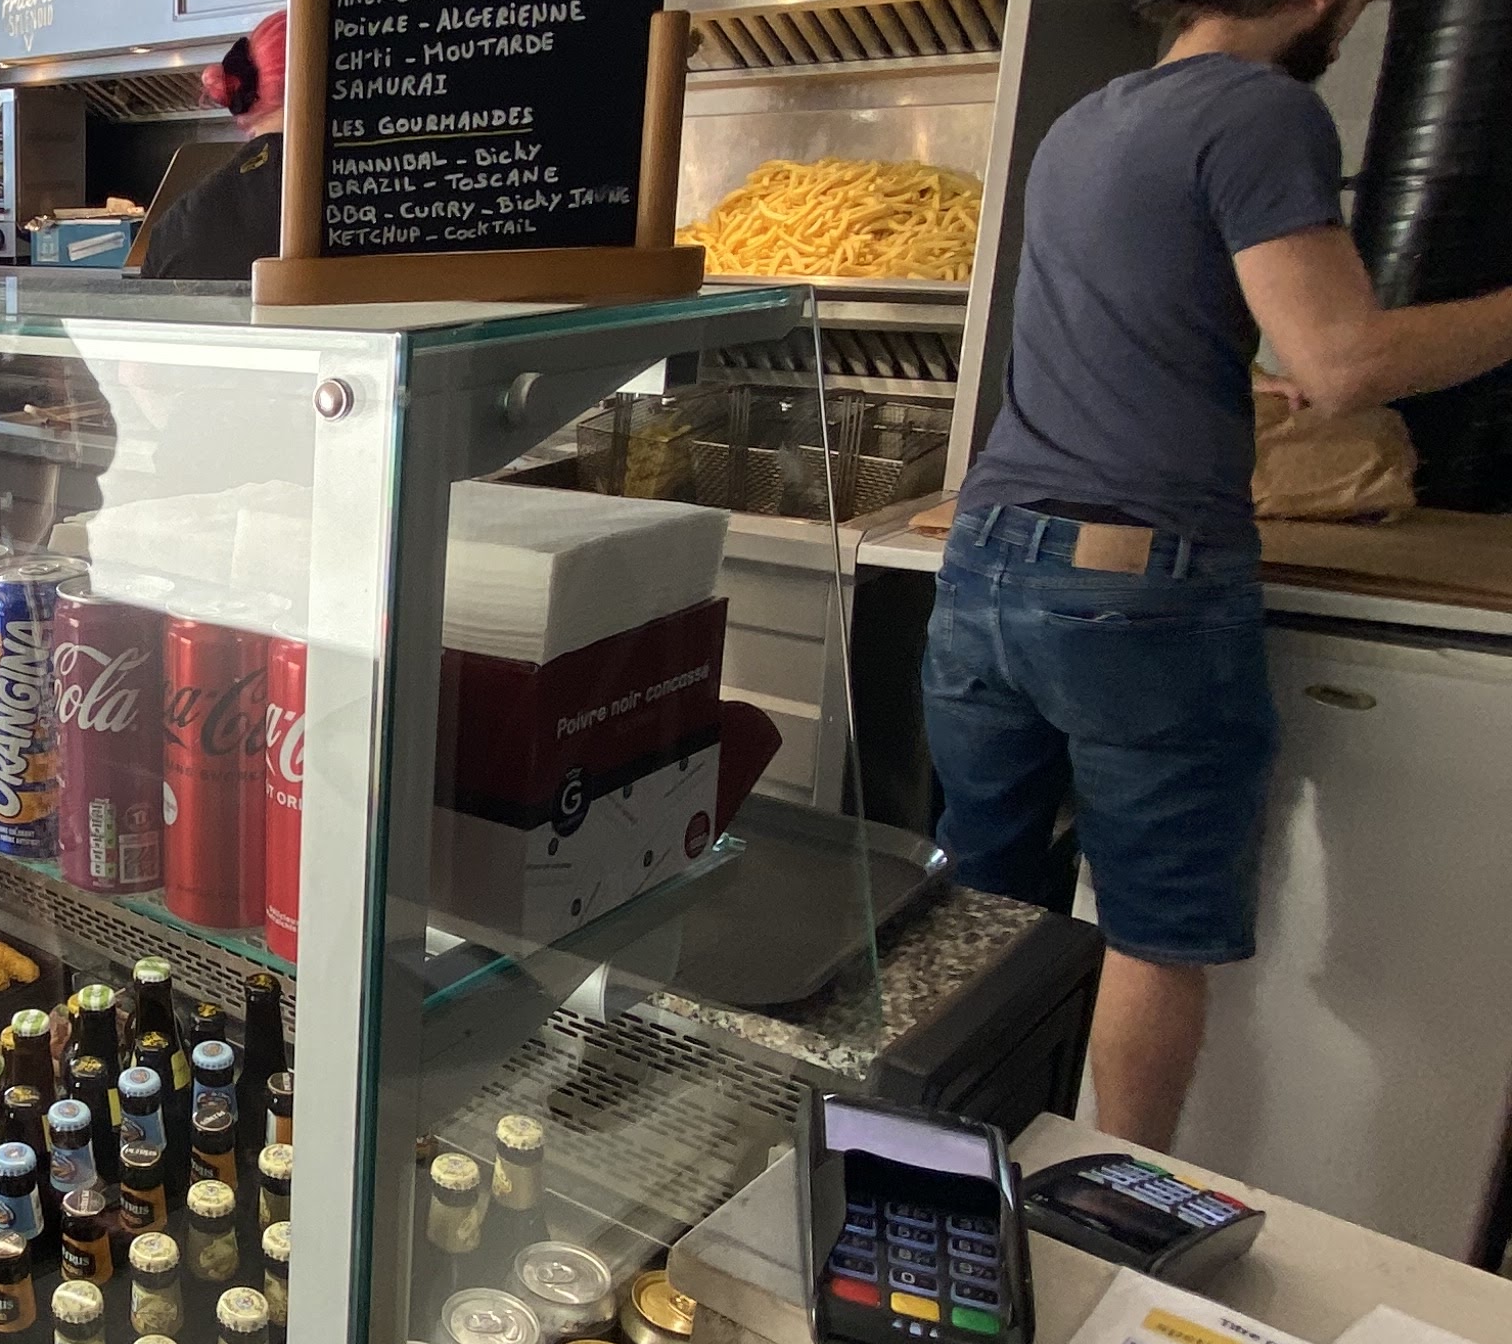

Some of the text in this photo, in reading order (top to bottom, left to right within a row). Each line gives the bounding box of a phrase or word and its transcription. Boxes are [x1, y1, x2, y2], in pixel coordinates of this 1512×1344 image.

[423, 31, 555, 66] MOUTARDE
[332, 72, 448, 101] SAMURAI
[331, 106, 535, 139] LES GOURMANDES
[332, 139, 543, 176] HANNIBAL Bicky
[328, 166, 560, 199] BRAZIL TOSCANE
[326, 205, 377, 225] BBQ
[399, 200, 477, 221] CURRY
[496, 190, 563, 214] Bicky
[328, 224, 422, 247] KETCHUP
[557, 706, 607, 739] Poivre
[611, 689, 642, 717] noir
[561, 779, 583, 816] G
